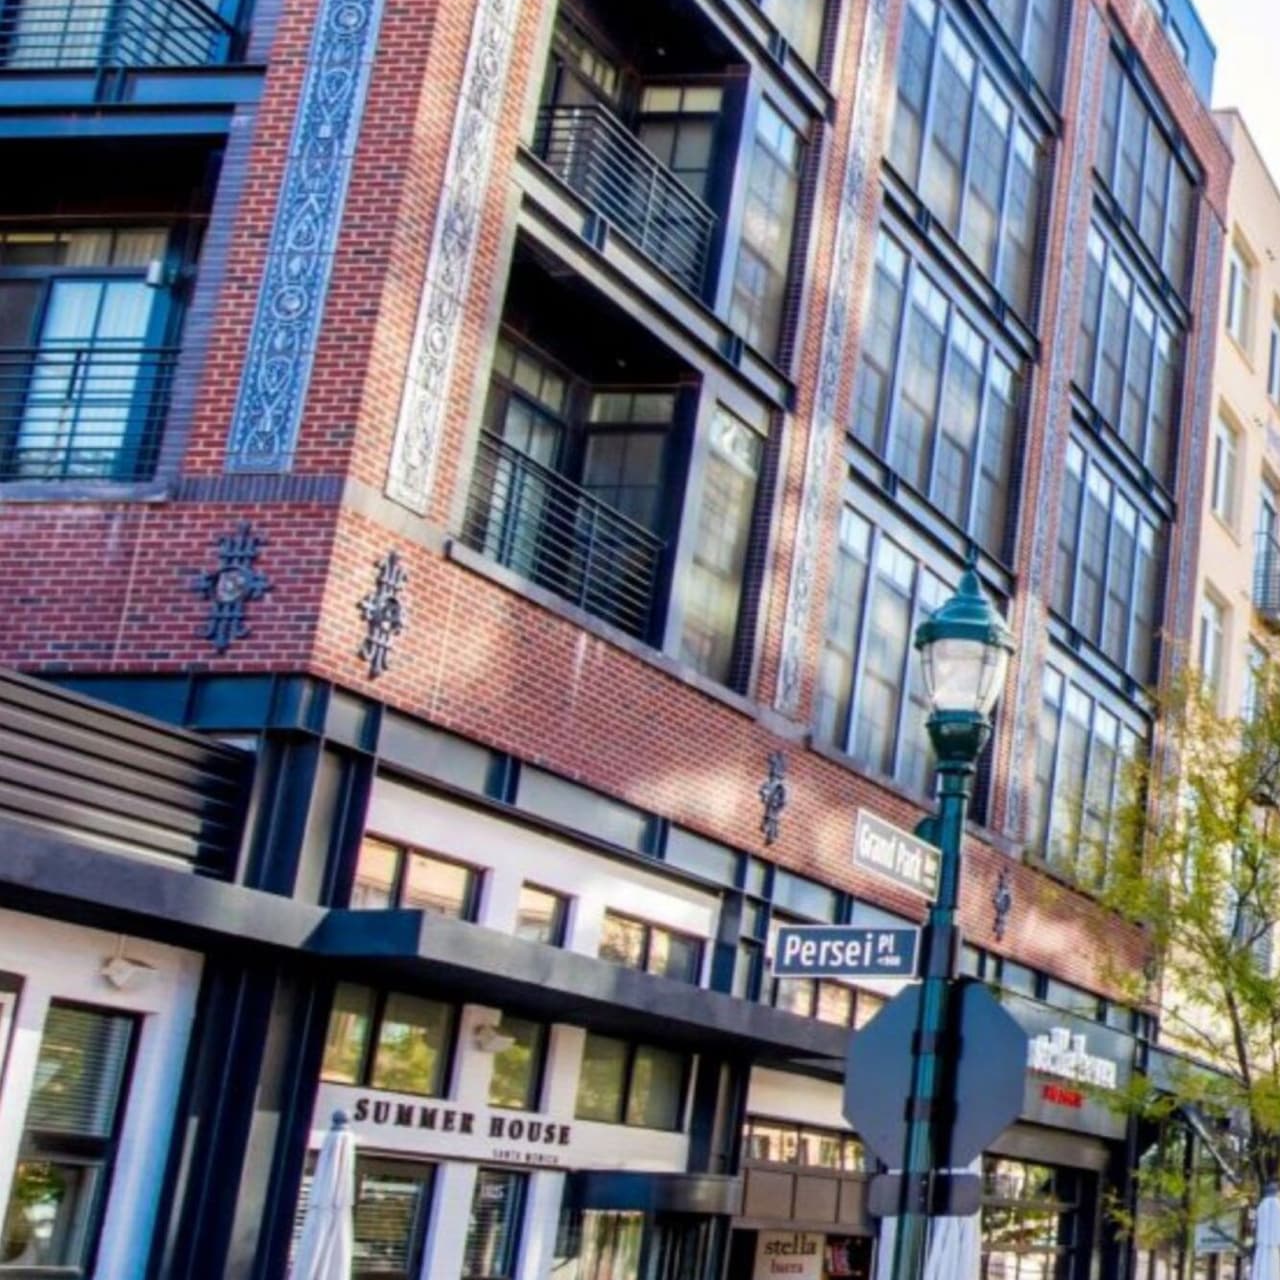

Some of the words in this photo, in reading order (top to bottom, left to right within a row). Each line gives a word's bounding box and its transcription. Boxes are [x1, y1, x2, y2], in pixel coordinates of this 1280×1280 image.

[783, 933, 873, 967] Persei
[877, 933, 895, 953] Pl
[353, 1098, 476, 1135] SUMMER
[488, 1116, 572, 1146] HOUSE
[764, 1232, 817, 1256] stella
